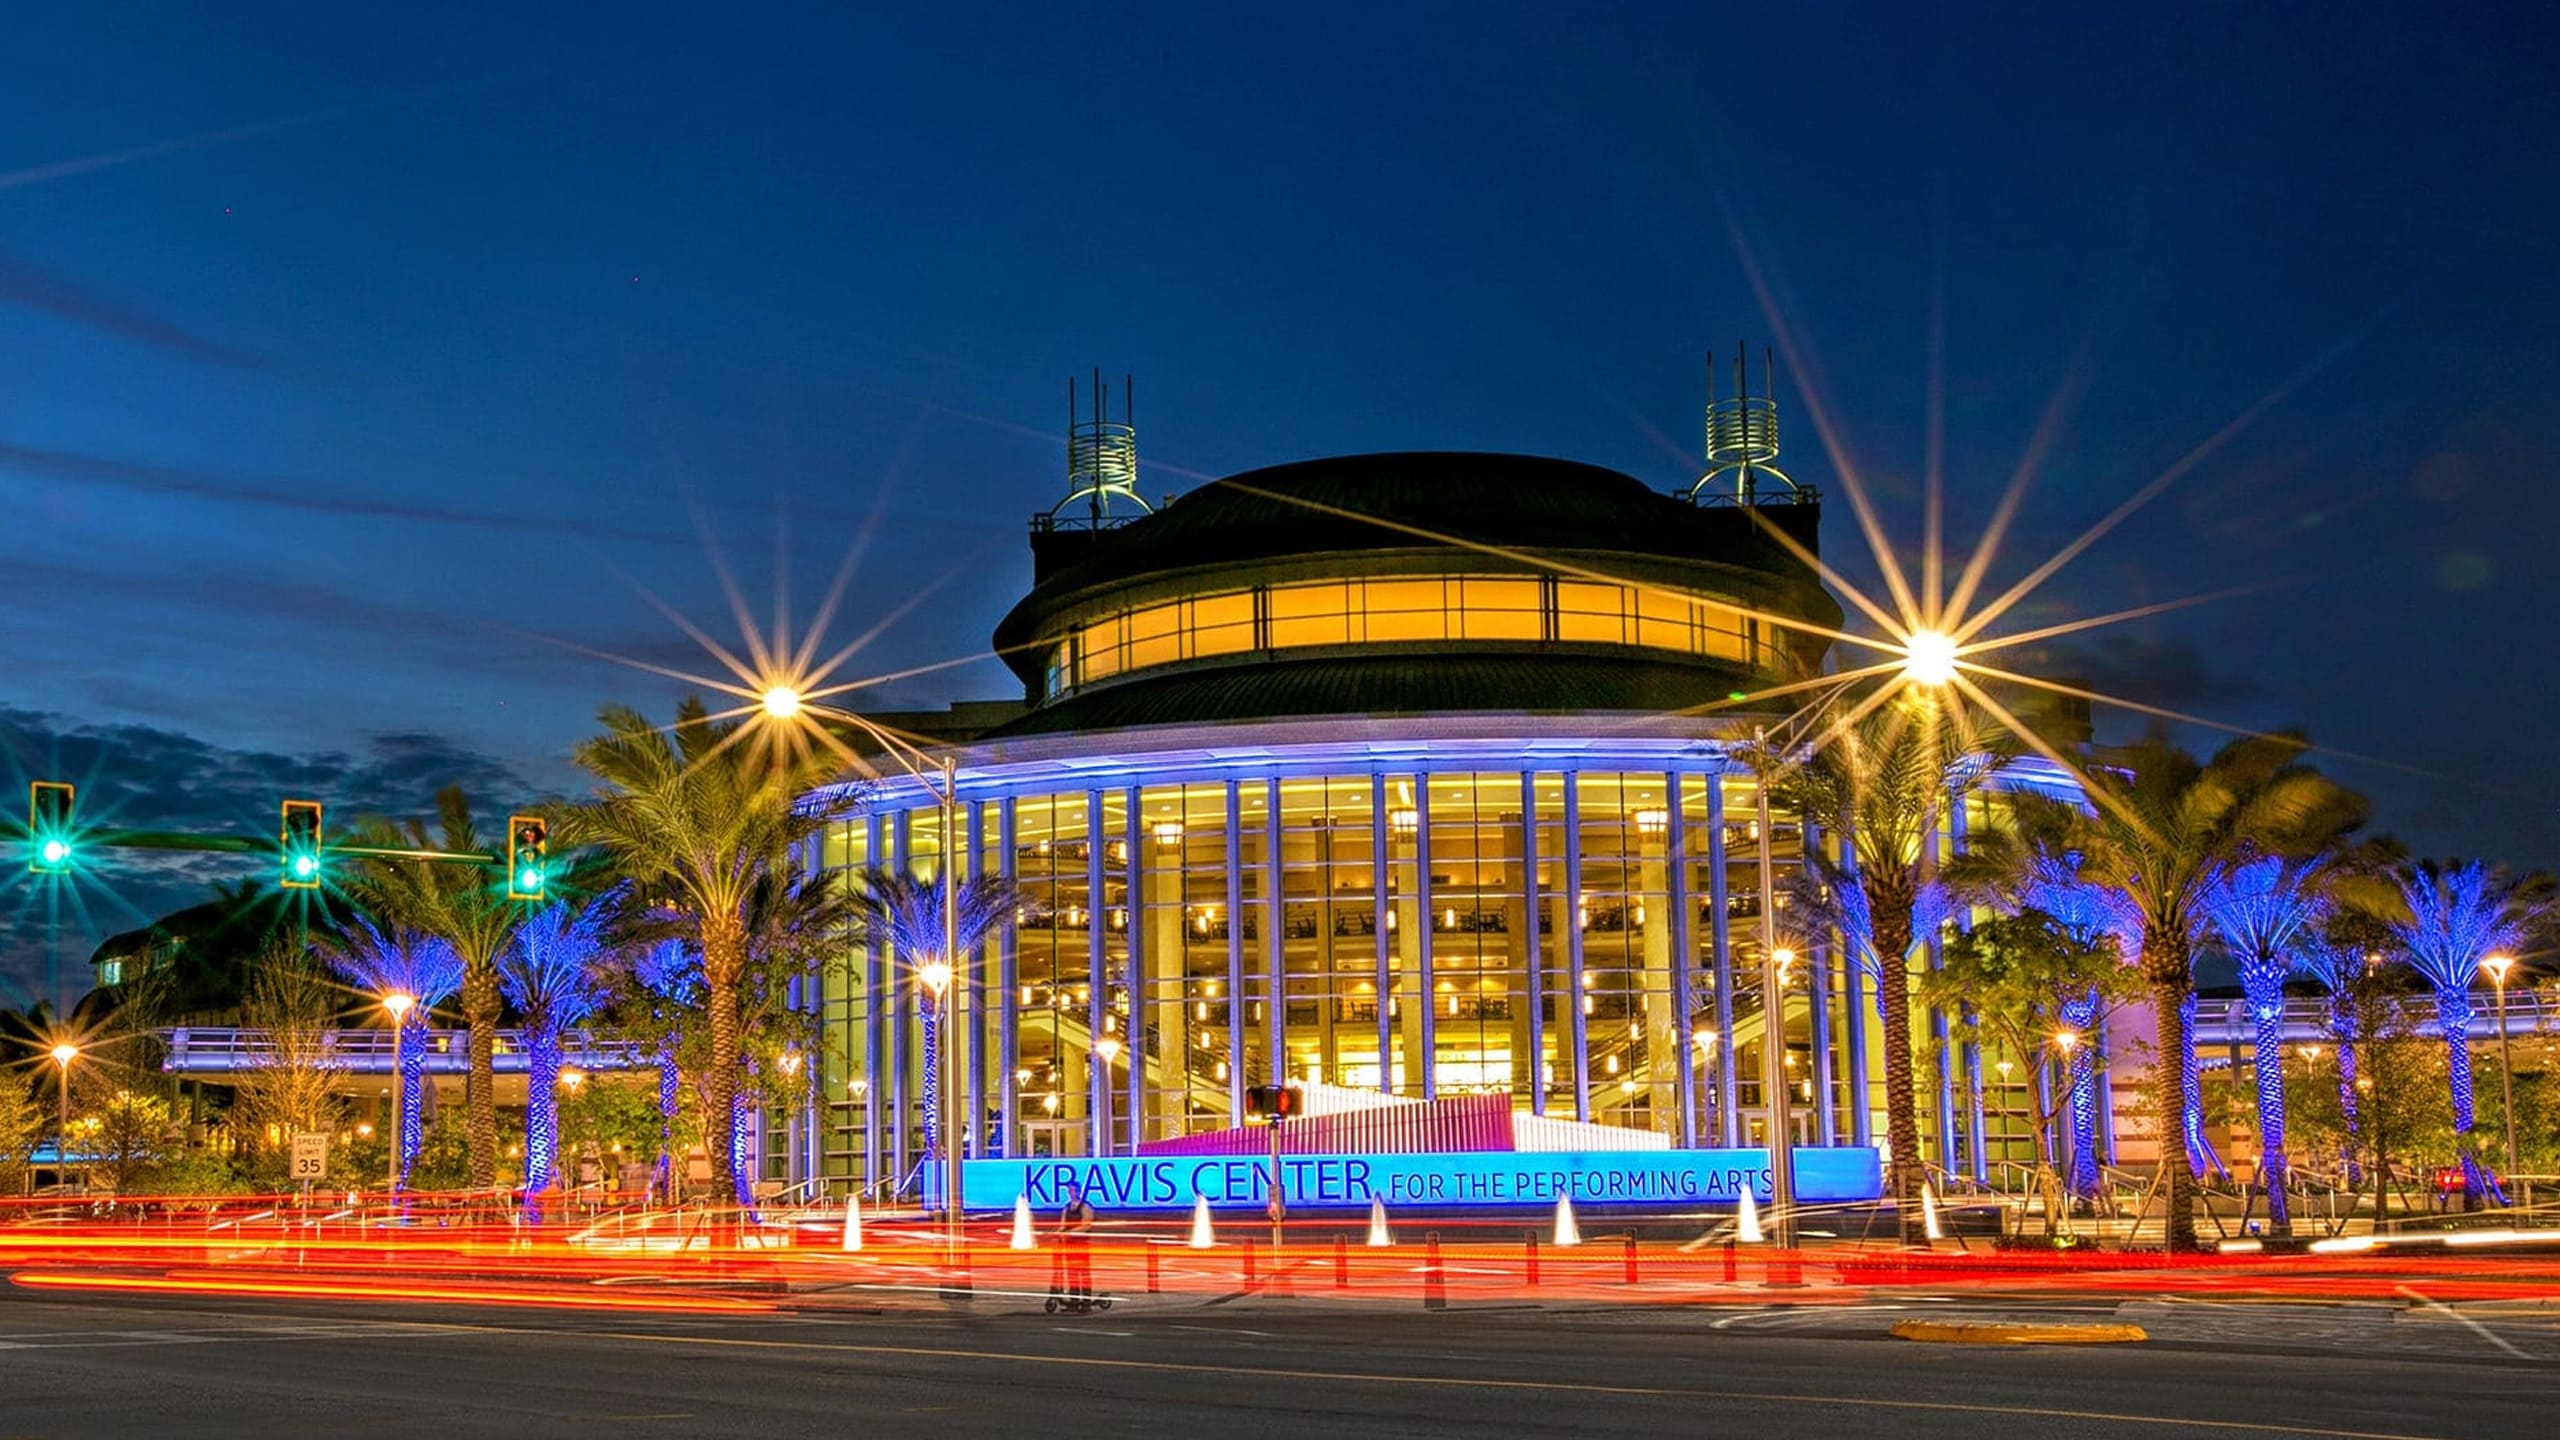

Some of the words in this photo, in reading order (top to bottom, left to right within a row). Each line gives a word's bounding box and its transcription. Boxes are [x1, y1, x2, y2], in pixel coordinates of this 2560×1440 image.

[299, 1148, 320, 1156] LIMIT
[298, 1159, 321, 1174] 35
[1025, 1162, 1177, 1203] KRAVIS
[1191, 1160, 1372, 1201] CENTER
[1391, 1173, 1444, 1199] FOR
[1454, 1173, 1505, 1198] THE
[1516, 1170, 1697, 1198] PERFORMING
[1707, 1169, 1773, 1196] ARTS
